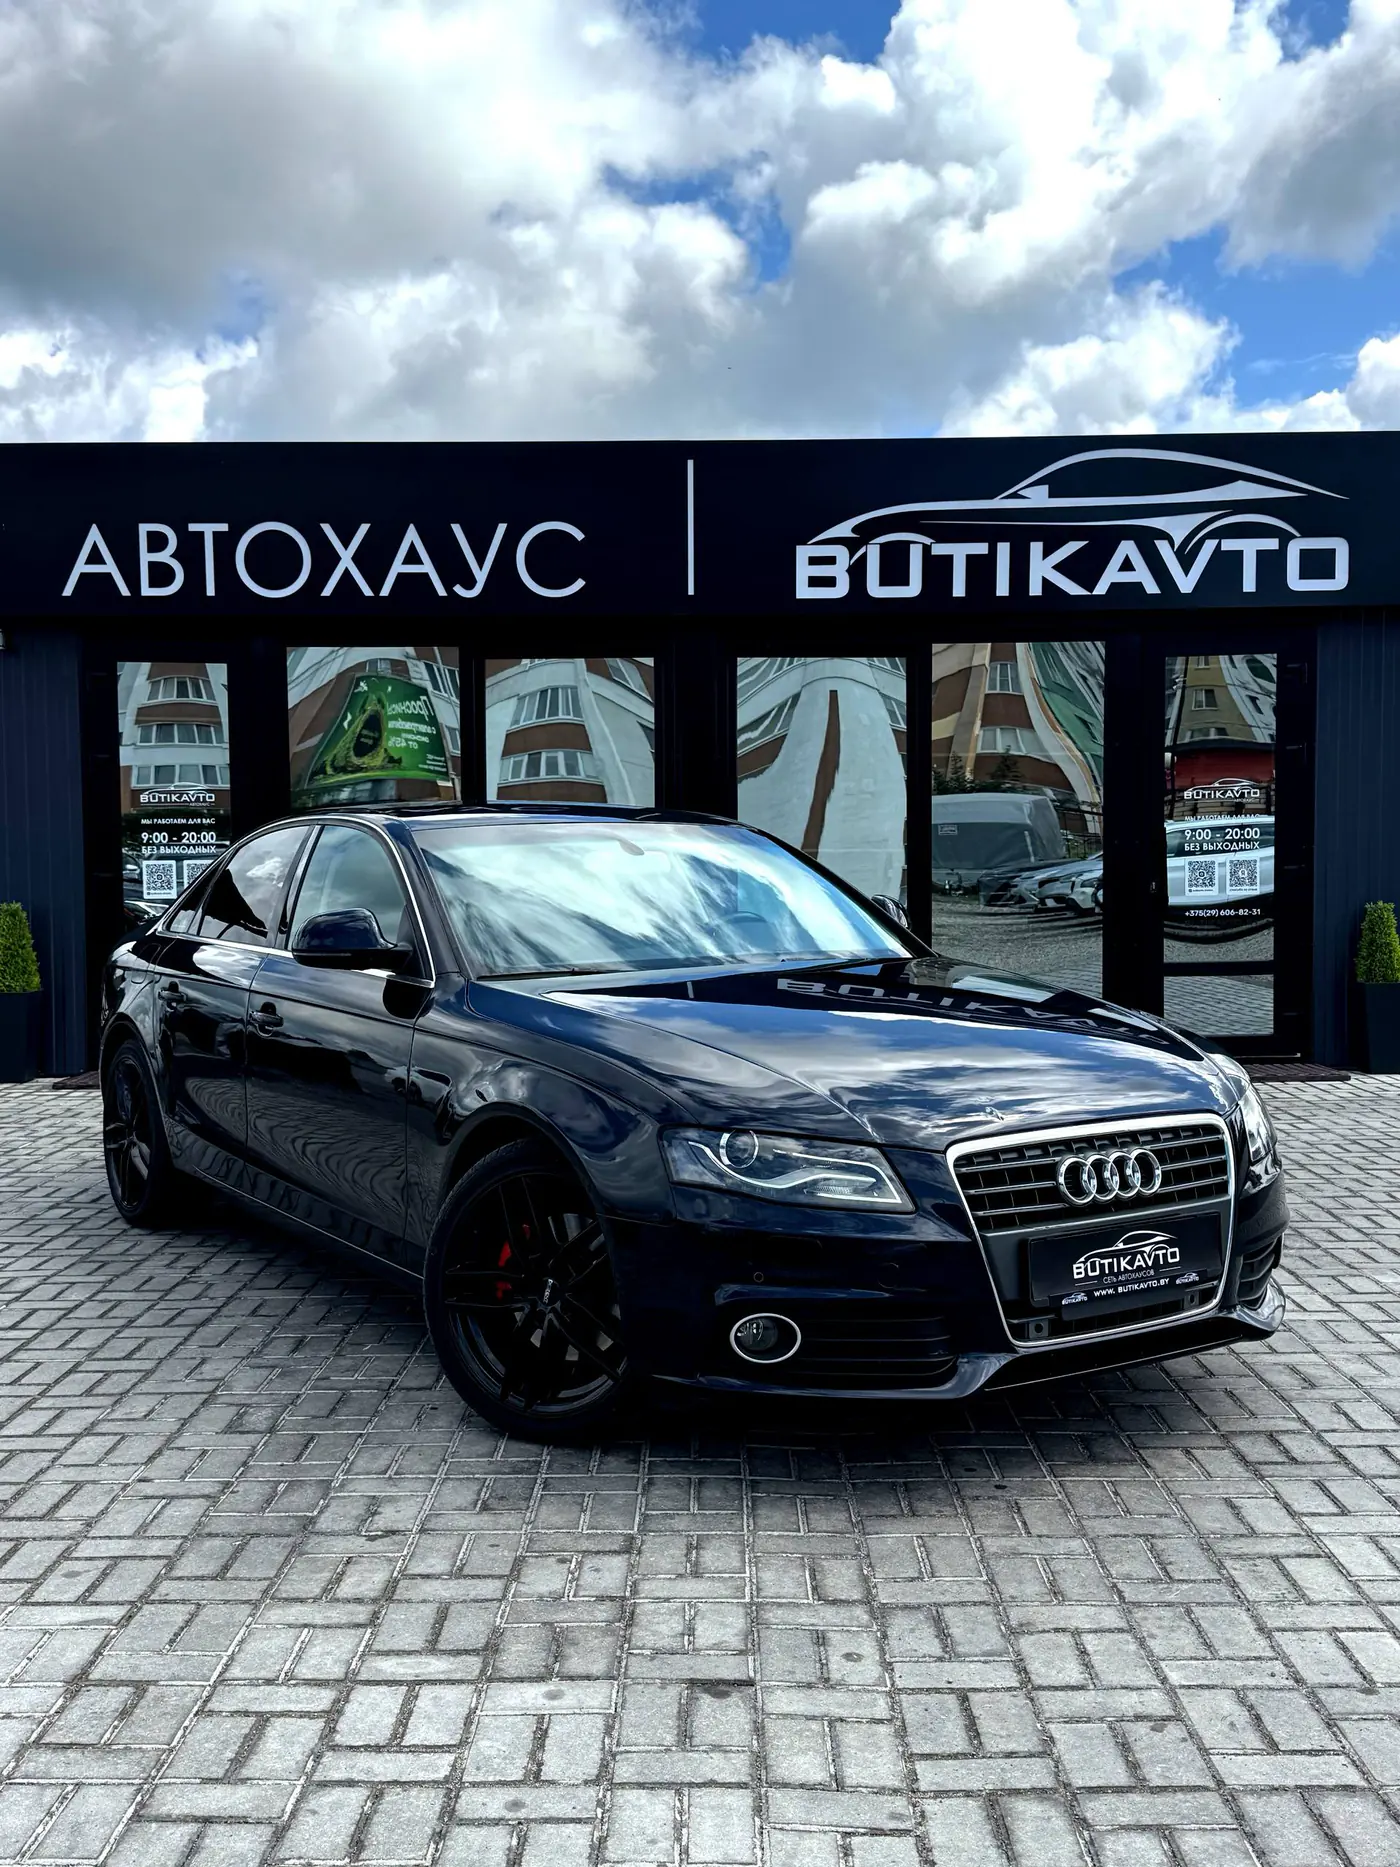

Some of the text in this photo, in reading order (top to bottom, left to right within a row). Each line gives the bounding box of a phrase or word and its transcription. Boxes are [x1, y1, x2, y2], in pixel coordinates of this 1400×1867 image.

[62, 520, 587, 599] АВТОХАУС
[795, 536, 1350, 599] BUTIKAVTO
[140, 793, 215, 803] BUTIKAVTO
[1184, 789, 1260, 799] BUTIKAVTO
[141, 832, 168, 843] 9:00
[181, 832, 216, 843] 20:00
[1185, 829, 1211, 840] 9:00
[1225, 828, 1260, 840] 20:00
[142, 845, 216, 854] БЕЗ ВЫХОДНЫХ
[1185, 841, 1260, 851] БЕЗ ВЫХОДНЫХ
[1185, 908, 1261, 917] +375(29) 606-82-31
[1073, 1247, 1180, 1279] BUTIKAVTO
[1103, 1268, 1155, 1284] СЕТЬ АВТОХАУСОВ
[1093, 1278, 1170, 1297] WWW. BUTIKAVTO.BY
